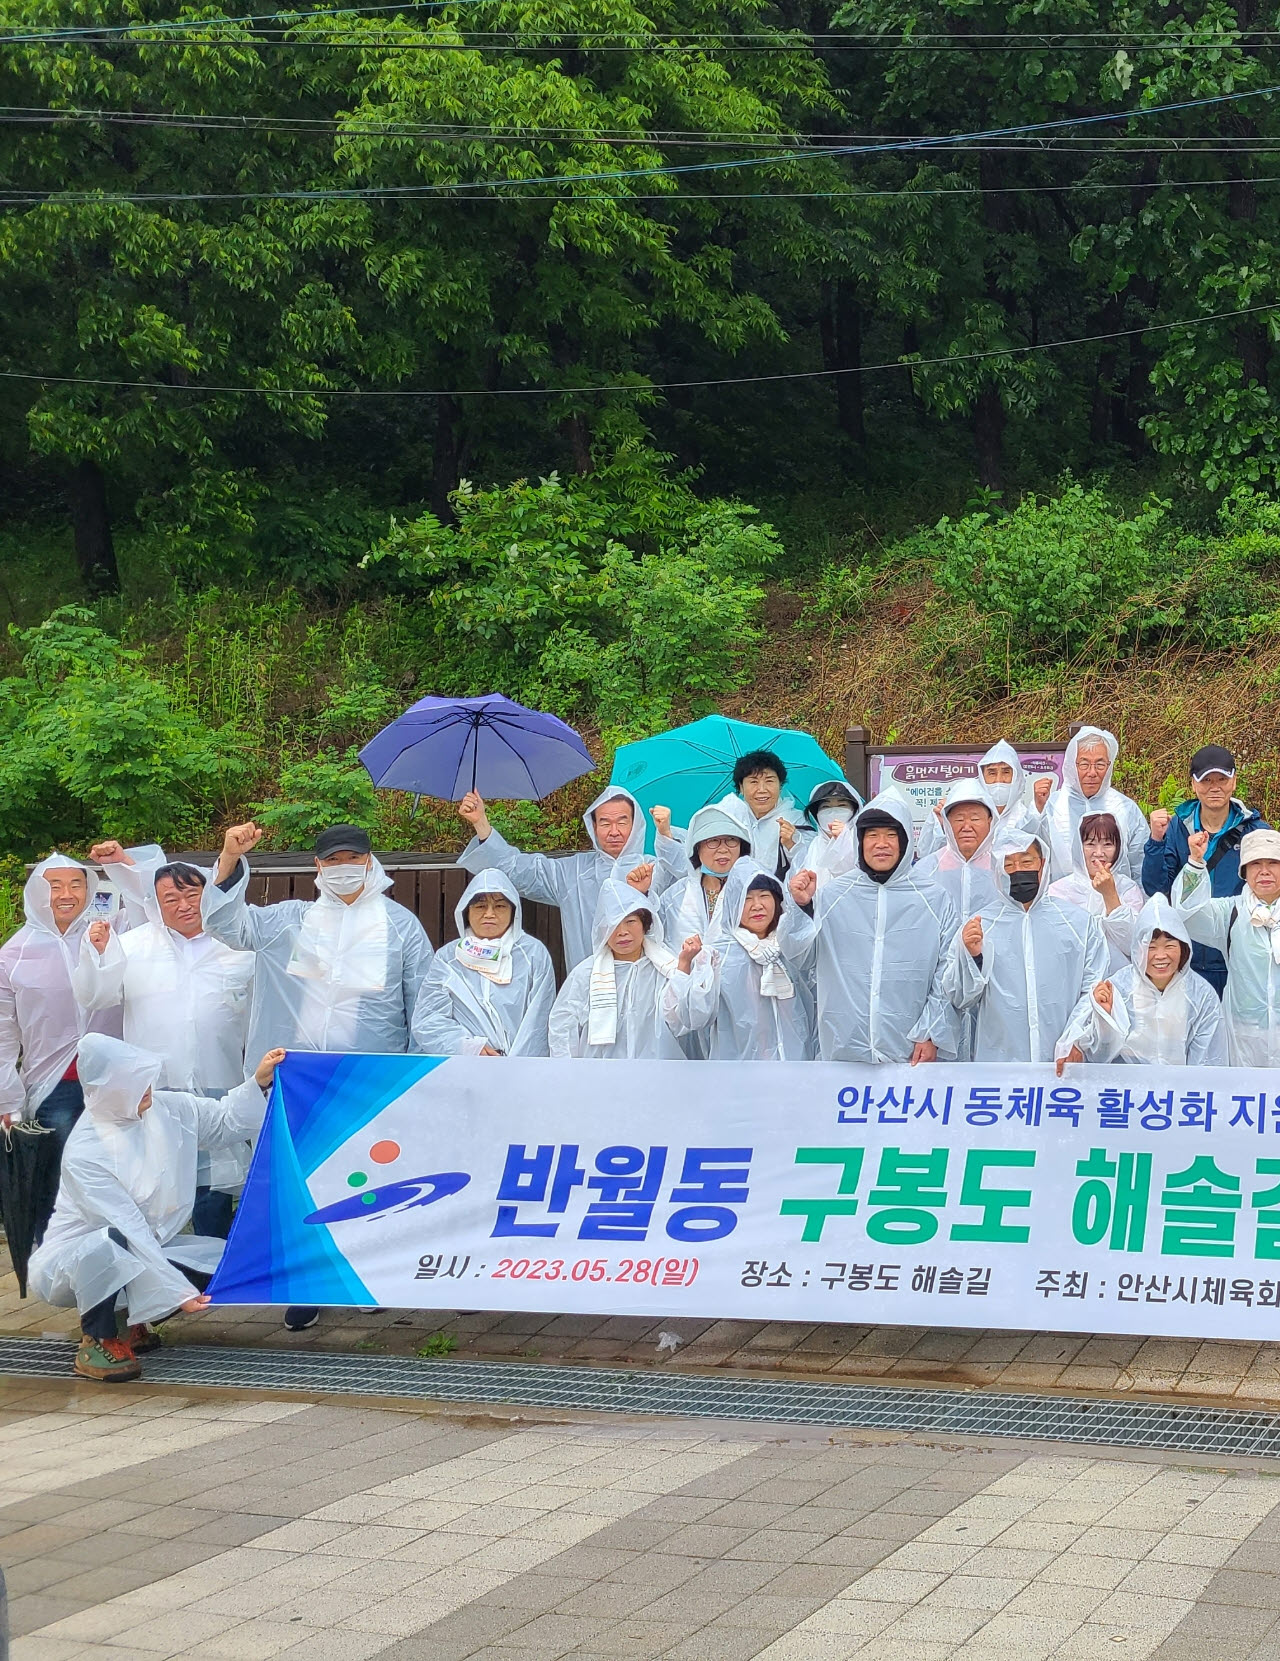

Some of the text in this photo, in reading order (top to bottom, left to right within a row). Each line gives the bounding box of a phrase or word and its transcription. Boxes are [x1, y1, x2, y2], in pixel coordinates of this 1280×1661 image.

[905, 764, 974, 780] 흙먼지 털이기
[837, 1085, 953, 1125] 안산시
[963, 1086, 1084, 1128] 동체육
[1096, 1088, 1218, 1132] 활성화
[489, 1144, 752, 1242] 반월동
[779, 1146, 1036, 1247] 구봉도
[413, 1254, 471, 1280] 일시
[491, 1257, 699, 1287] 2023.05.28(일)
[740, 1259, 793, 1288] 장소
[820, 1262, 902, 1292] 구봉도
[910, 1264, 991, 1296] 해솔길
[1035, 1270, 1089, 1300] 주최
